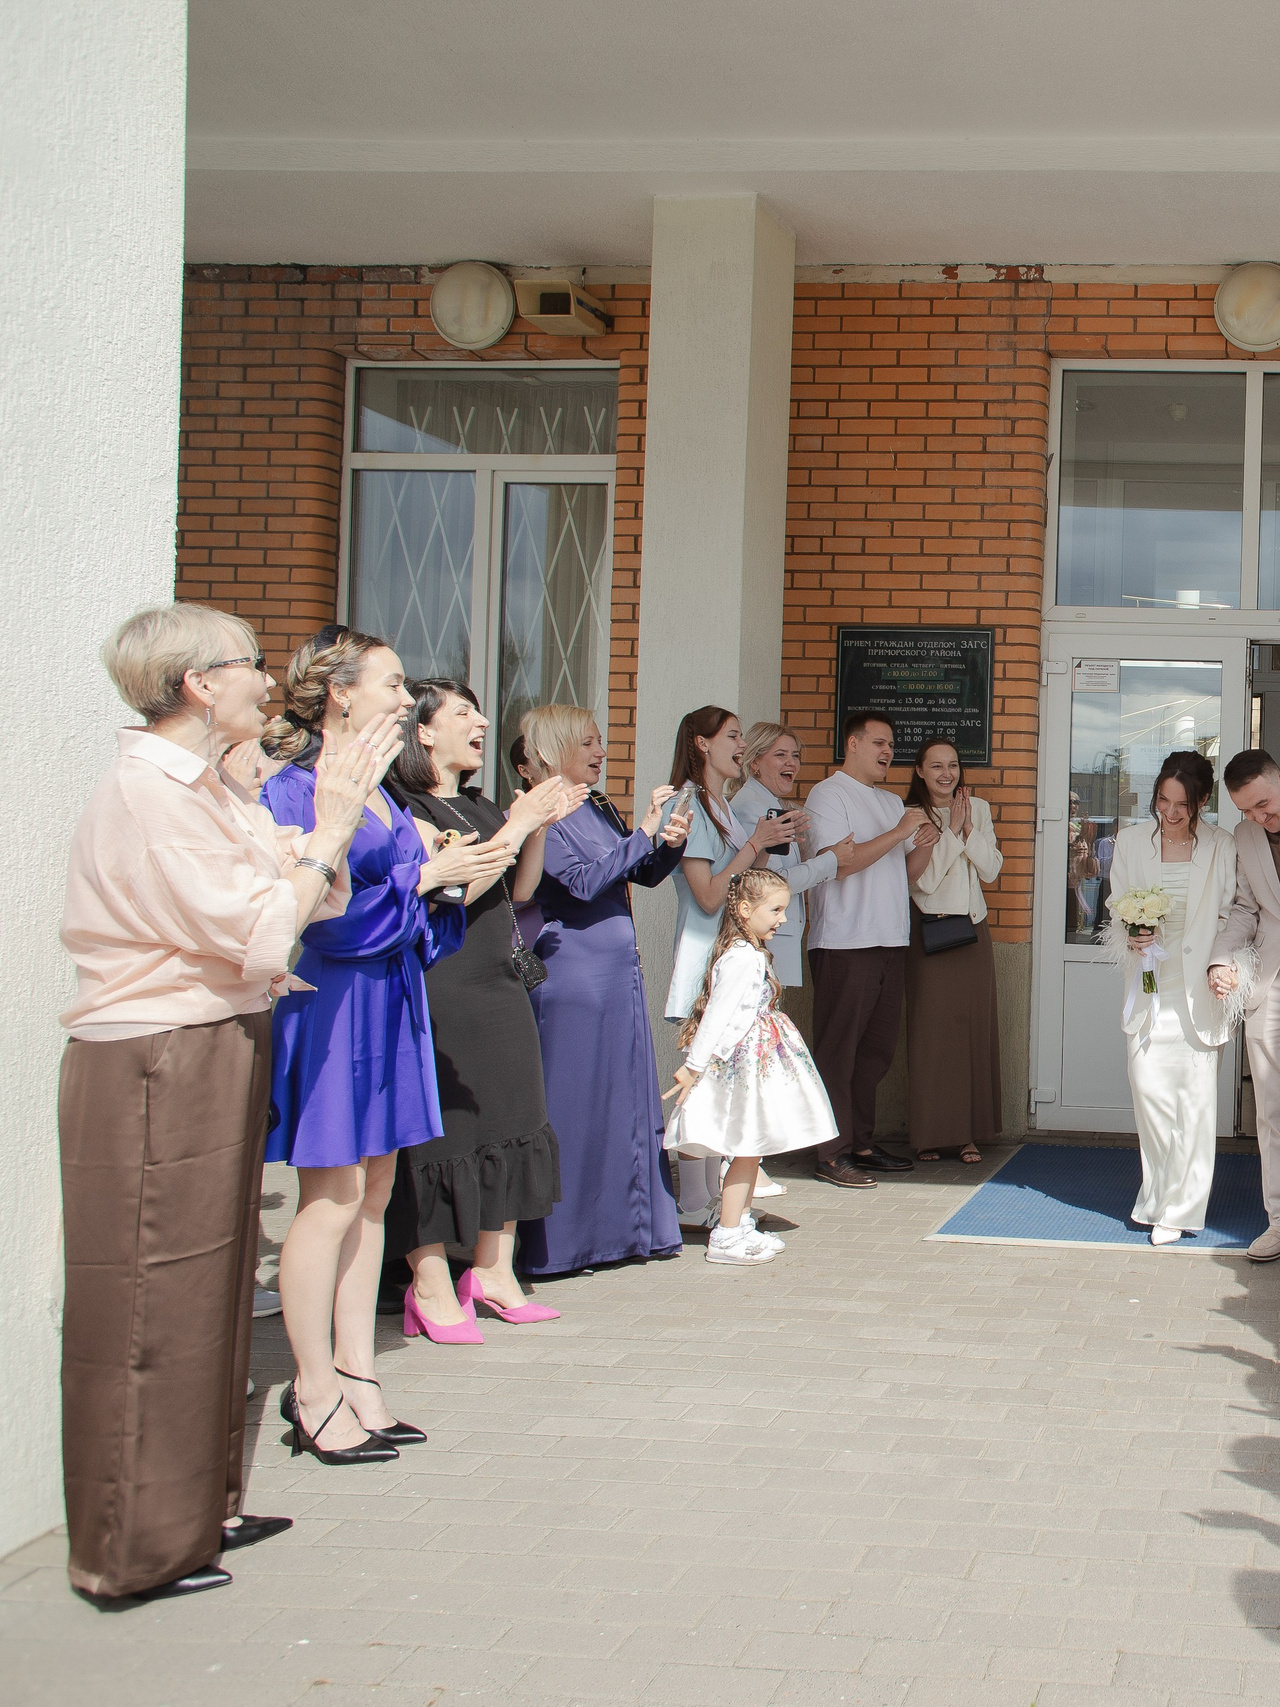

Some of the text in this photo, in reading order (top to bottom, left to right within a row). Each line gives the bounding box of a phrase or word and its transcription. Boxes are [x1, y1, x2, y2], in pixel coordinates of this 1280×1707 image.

[917, 641, 956, 649] ОТДЕЛОМ
[960, 641, 988, 649] ЗАГС
[930, 649, 962, 657] РАЙОНА
[960, 719, 982, 727] ЗАГС
